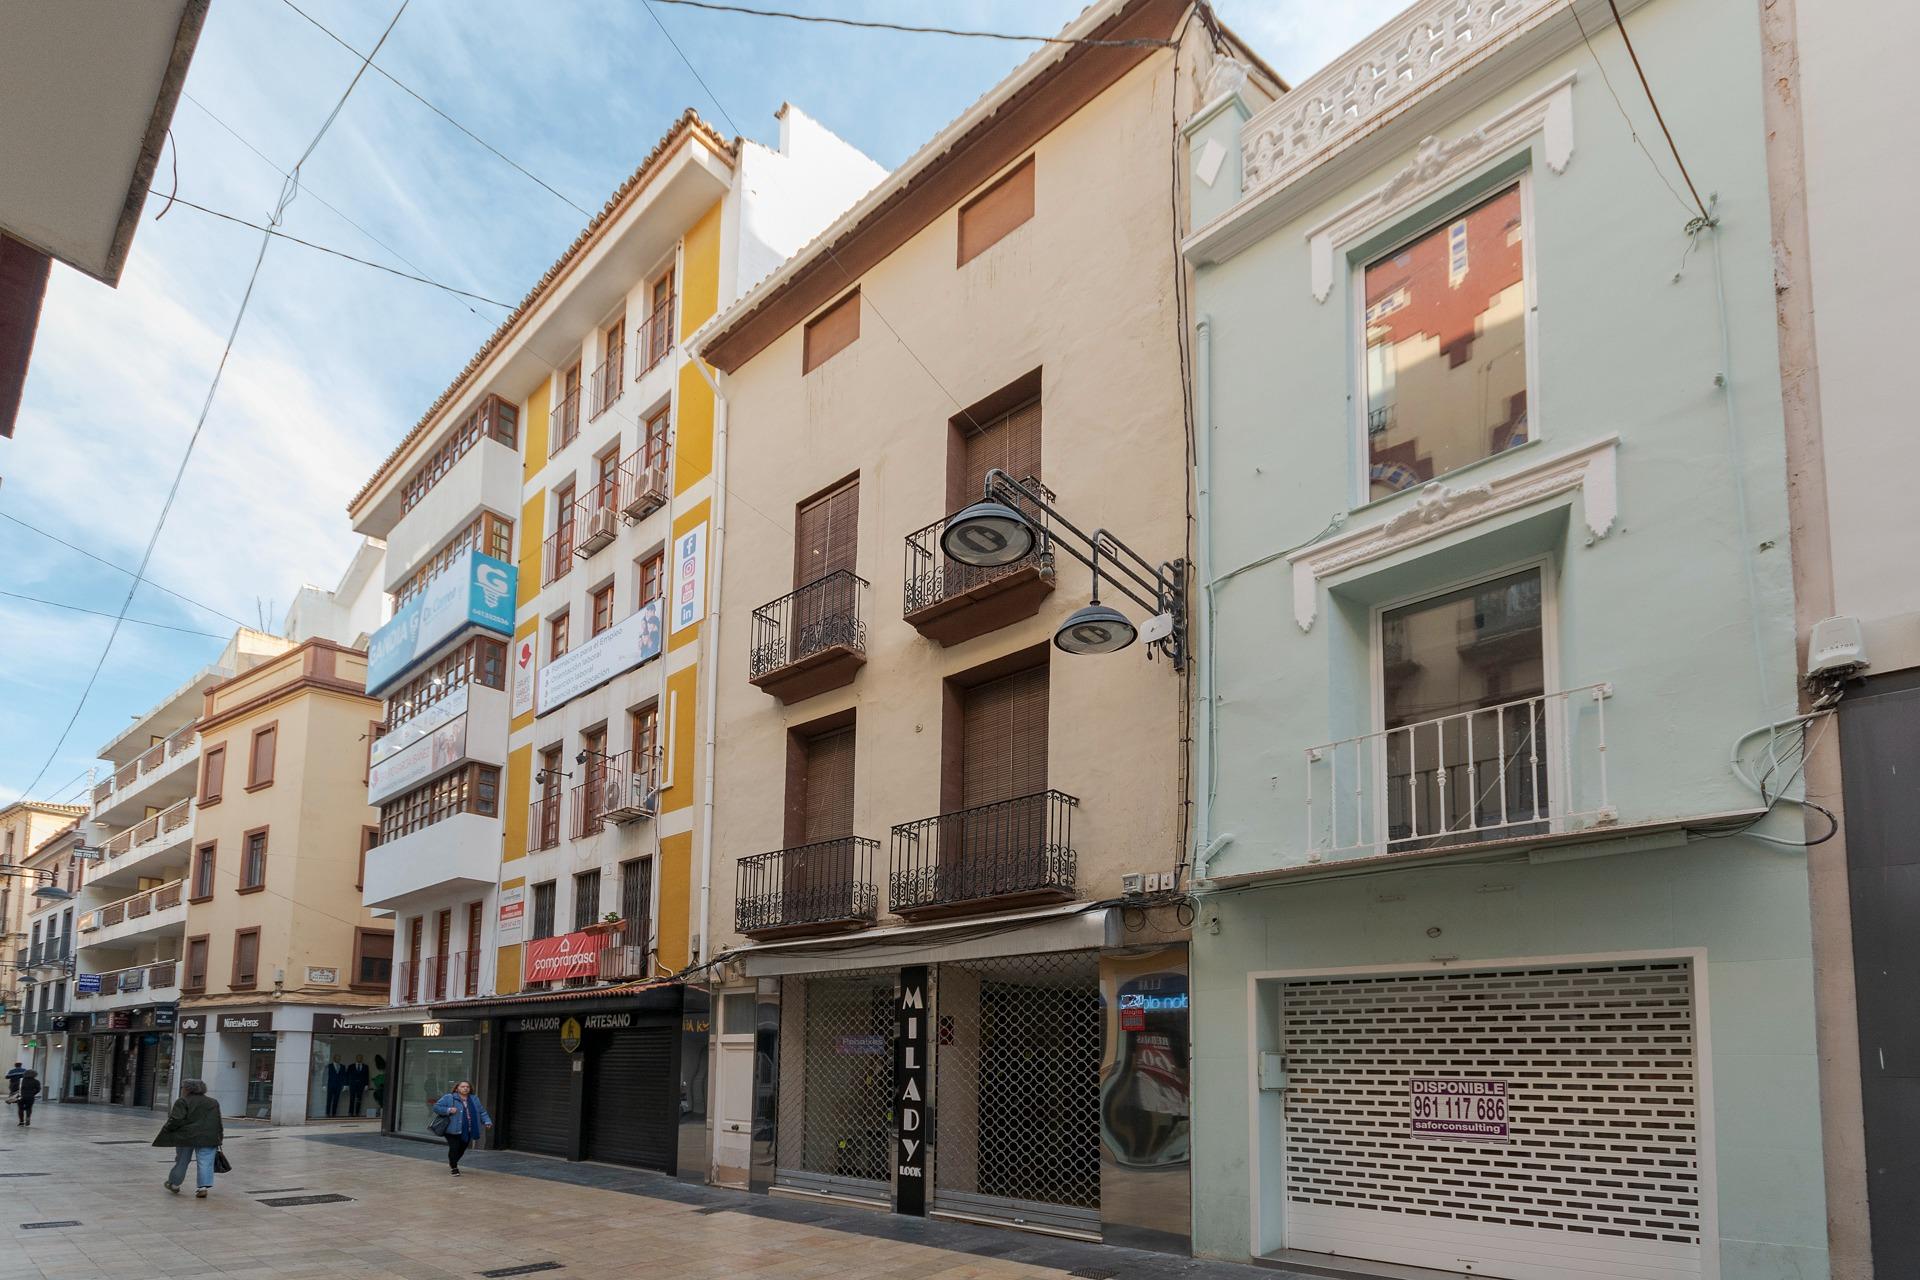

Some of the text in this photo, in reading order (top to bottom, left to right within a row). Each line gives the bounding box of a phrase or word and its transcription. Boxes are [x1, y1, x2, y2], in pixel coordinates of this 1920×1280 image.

[520, 1013, 631, 1031] SALVADOR ARTESANO
[422, 1023, 441, 1037] TOUS
[902, 986, 923, 1162] MILADY
[1413, 1081, 1504, 1095] DISPONIBLE
[1414, 1095, 1505, 1121] 961 117 686
[1415, 1121, 1501, 1134] saforconsulting
[900, 1165, 922, 1178] LOOK
